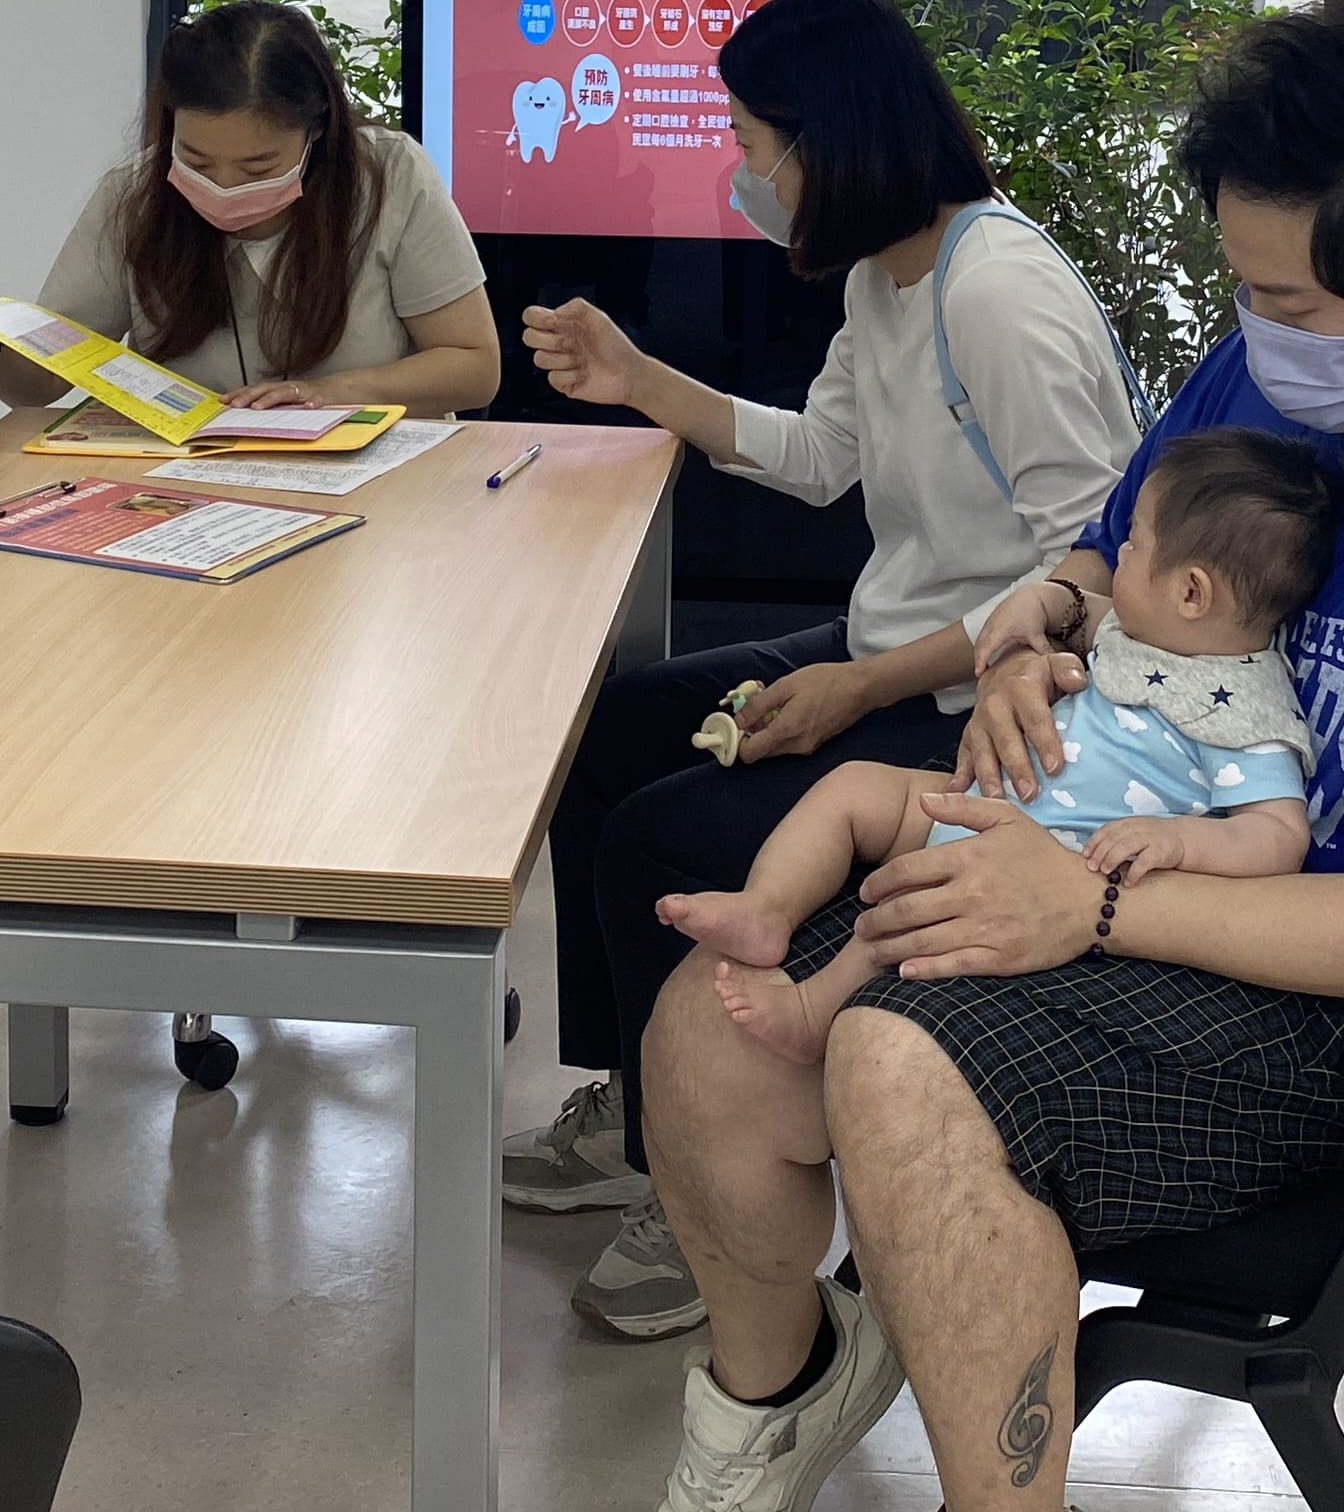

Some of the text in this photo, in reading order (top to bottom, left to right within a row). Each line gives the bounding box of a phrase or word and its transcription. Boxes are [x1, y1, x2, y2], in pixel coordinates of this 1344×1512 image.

[584, 69, 609, 86] 預防
[578, 89, 614, 106] 牙周病
